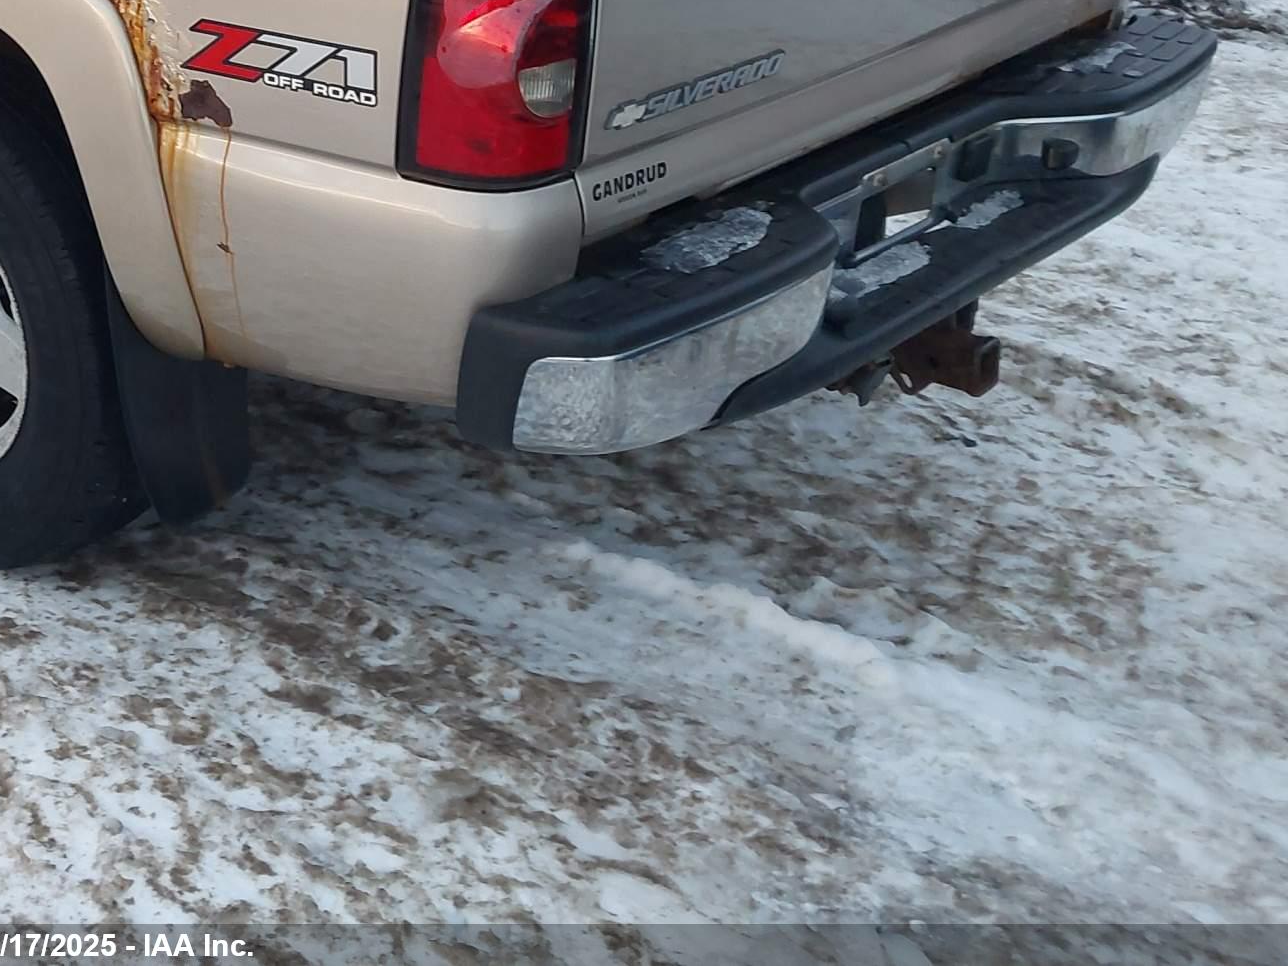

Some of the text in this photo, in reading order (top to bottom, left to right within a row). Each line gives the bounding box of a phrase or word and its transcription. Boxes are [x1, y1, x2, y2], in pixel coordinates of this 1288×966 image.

[180, 18, 378, 91] Z71
[263, 72, 378, 107] OFF ROAD
[642, 50, 786, 120] SILVERADO
[592, 161, 668, 202] GANDRUD
